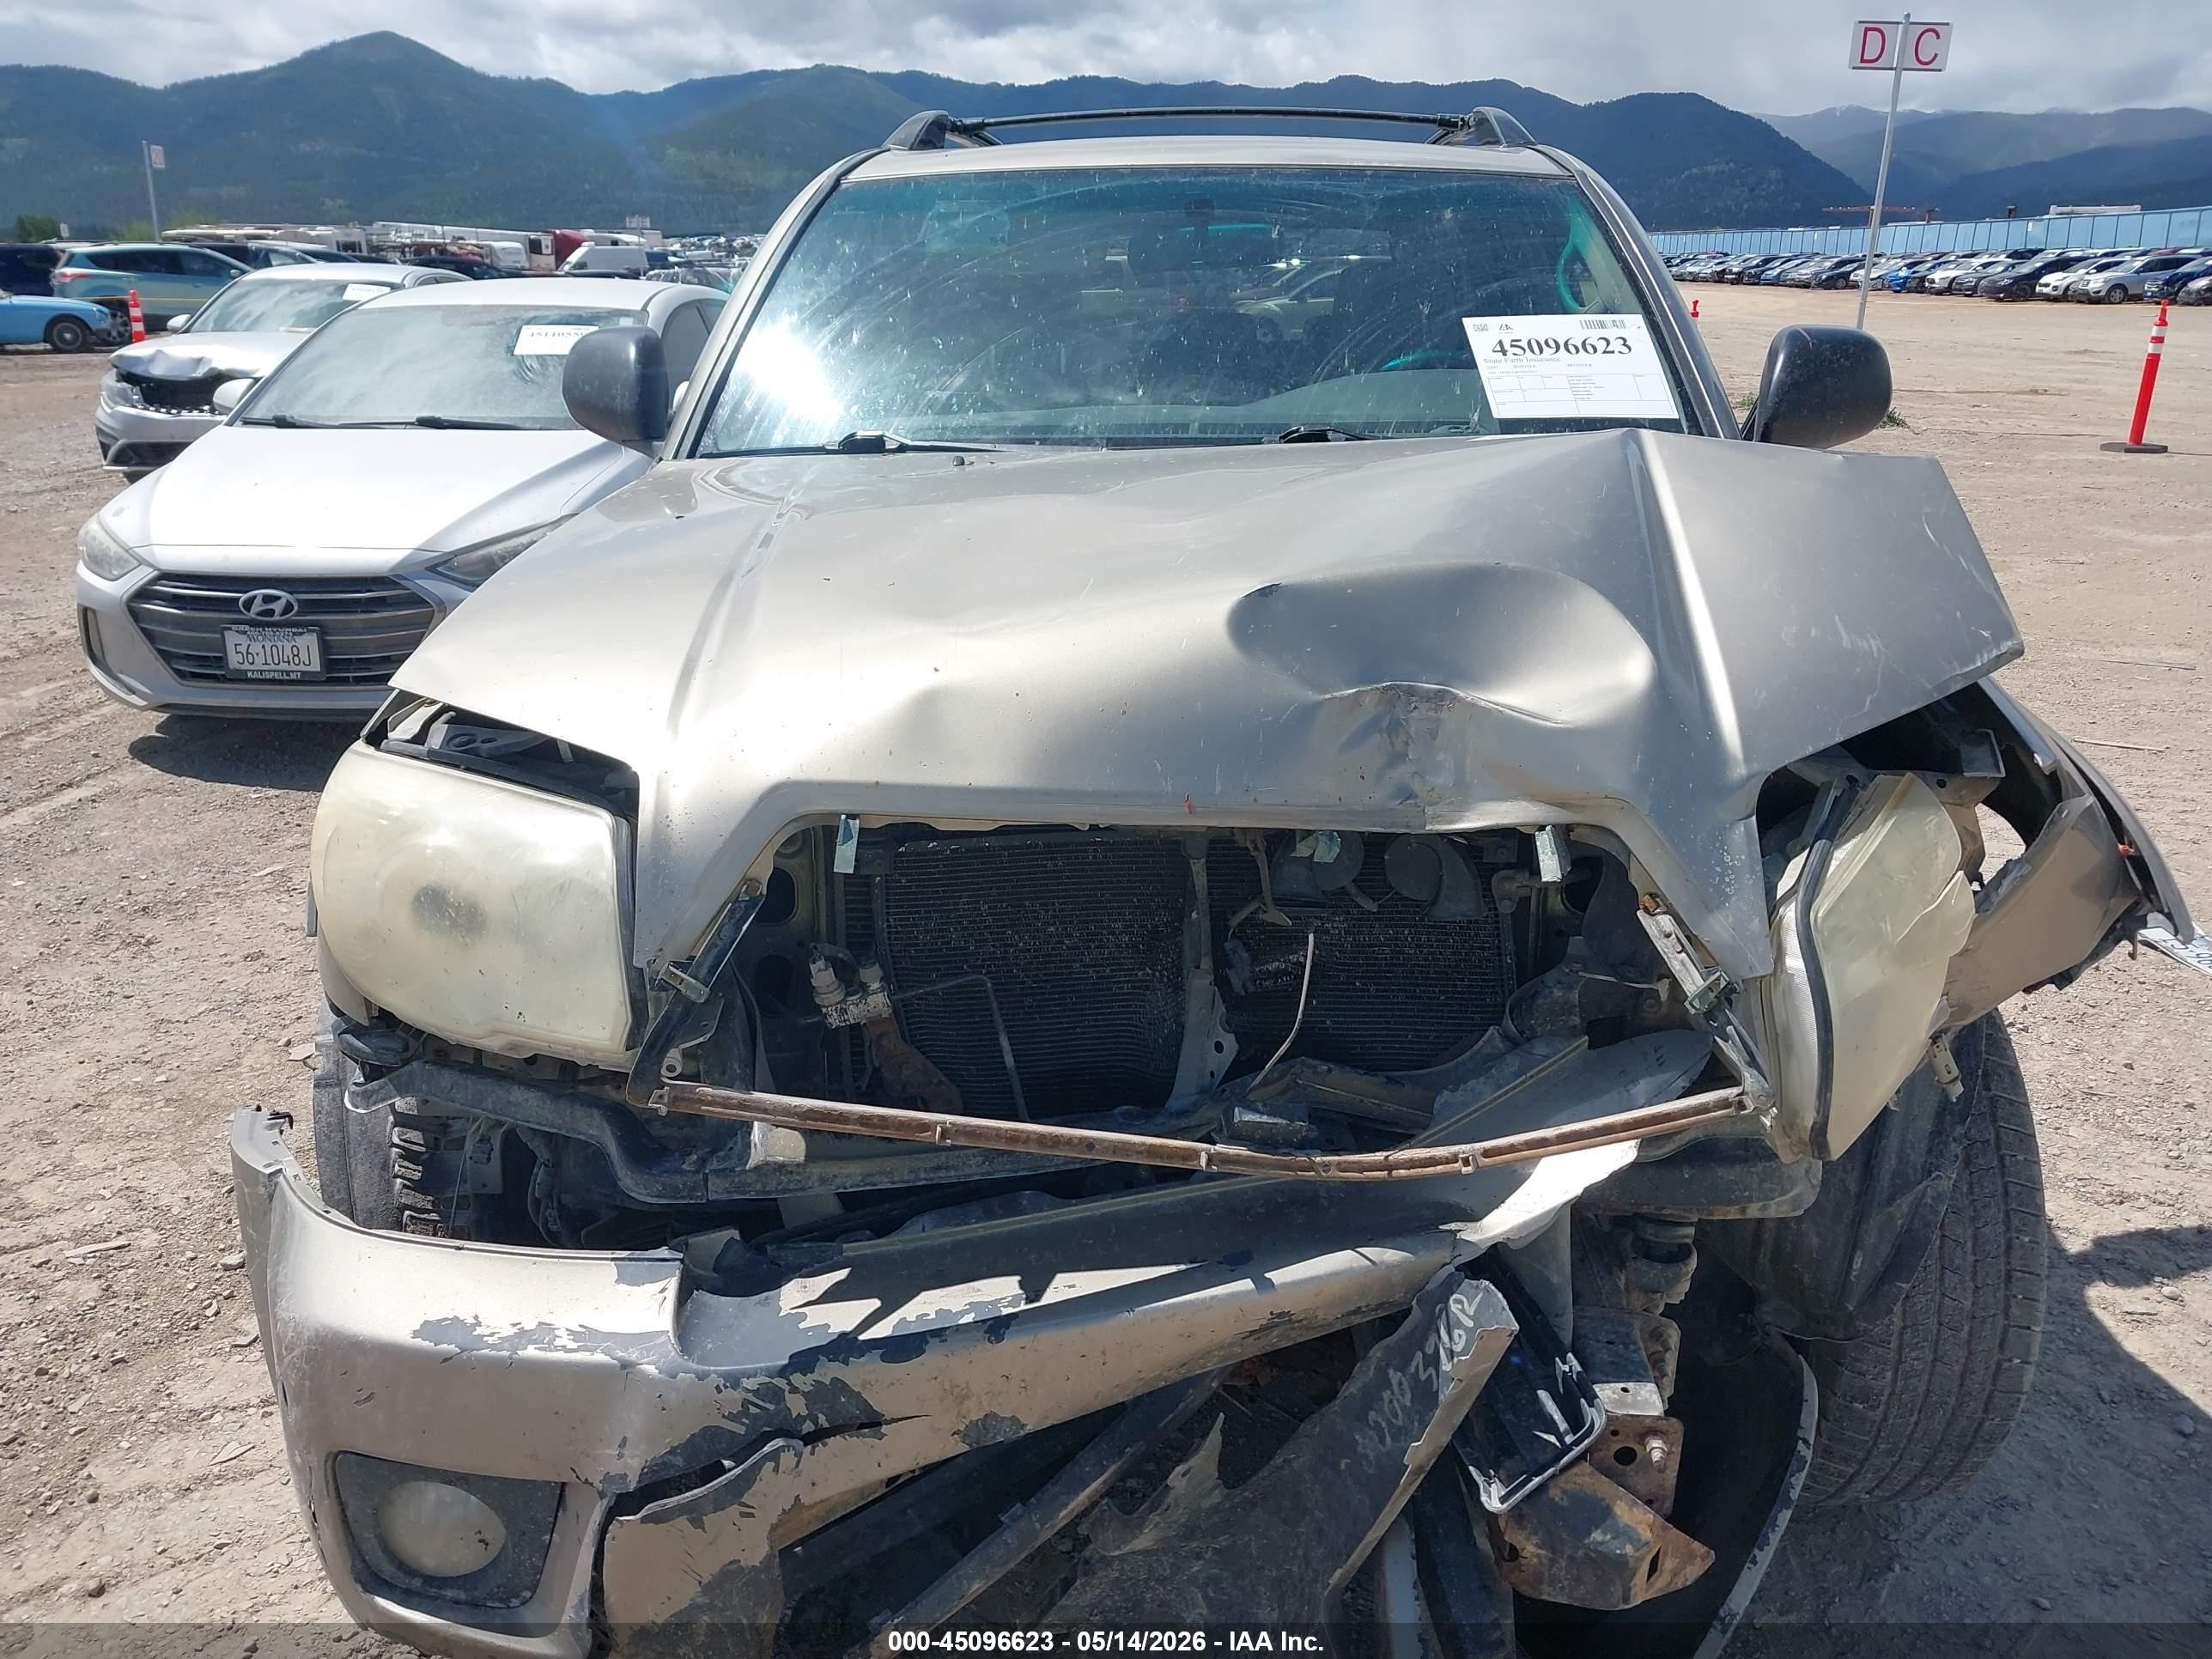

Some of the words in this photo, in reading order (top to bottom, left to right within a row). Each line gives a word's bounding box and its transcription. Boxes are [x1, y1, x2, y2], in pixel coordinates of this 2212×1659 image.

[1859, 26, 1887, 64] D
[1914, 27, 1941, 66] C
[1492, 336, 1632, 356] 45096623
